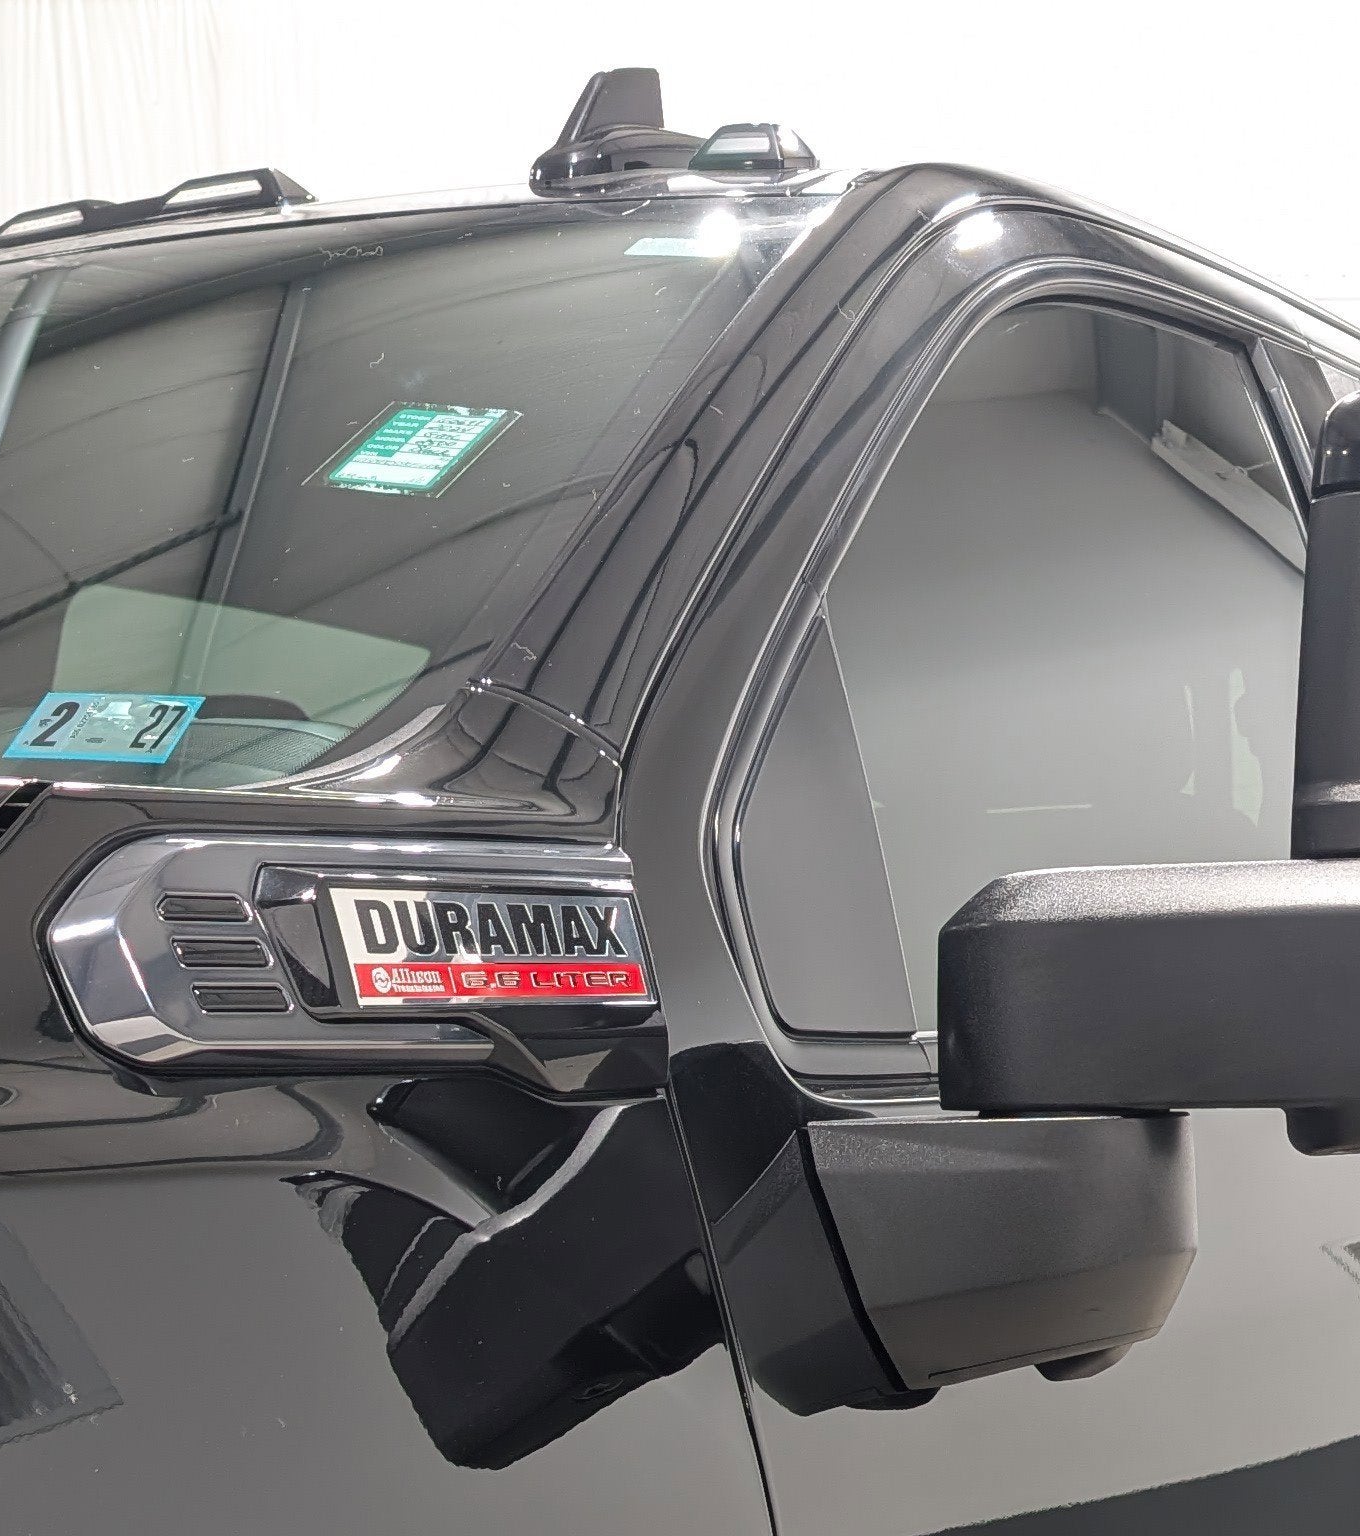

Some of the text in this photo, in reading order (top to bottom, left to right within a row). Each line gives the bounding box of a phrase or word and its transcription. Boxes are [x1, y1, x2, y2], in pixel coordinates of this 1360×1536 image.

[29, 701, 80, 747] 2
[129, 704, 189, 750] 27
[355, 899, 629, 958] DURAMAX
[391, 967, 443, 984] Allison
[460, 970, 633, 991] 6.6 LITER
